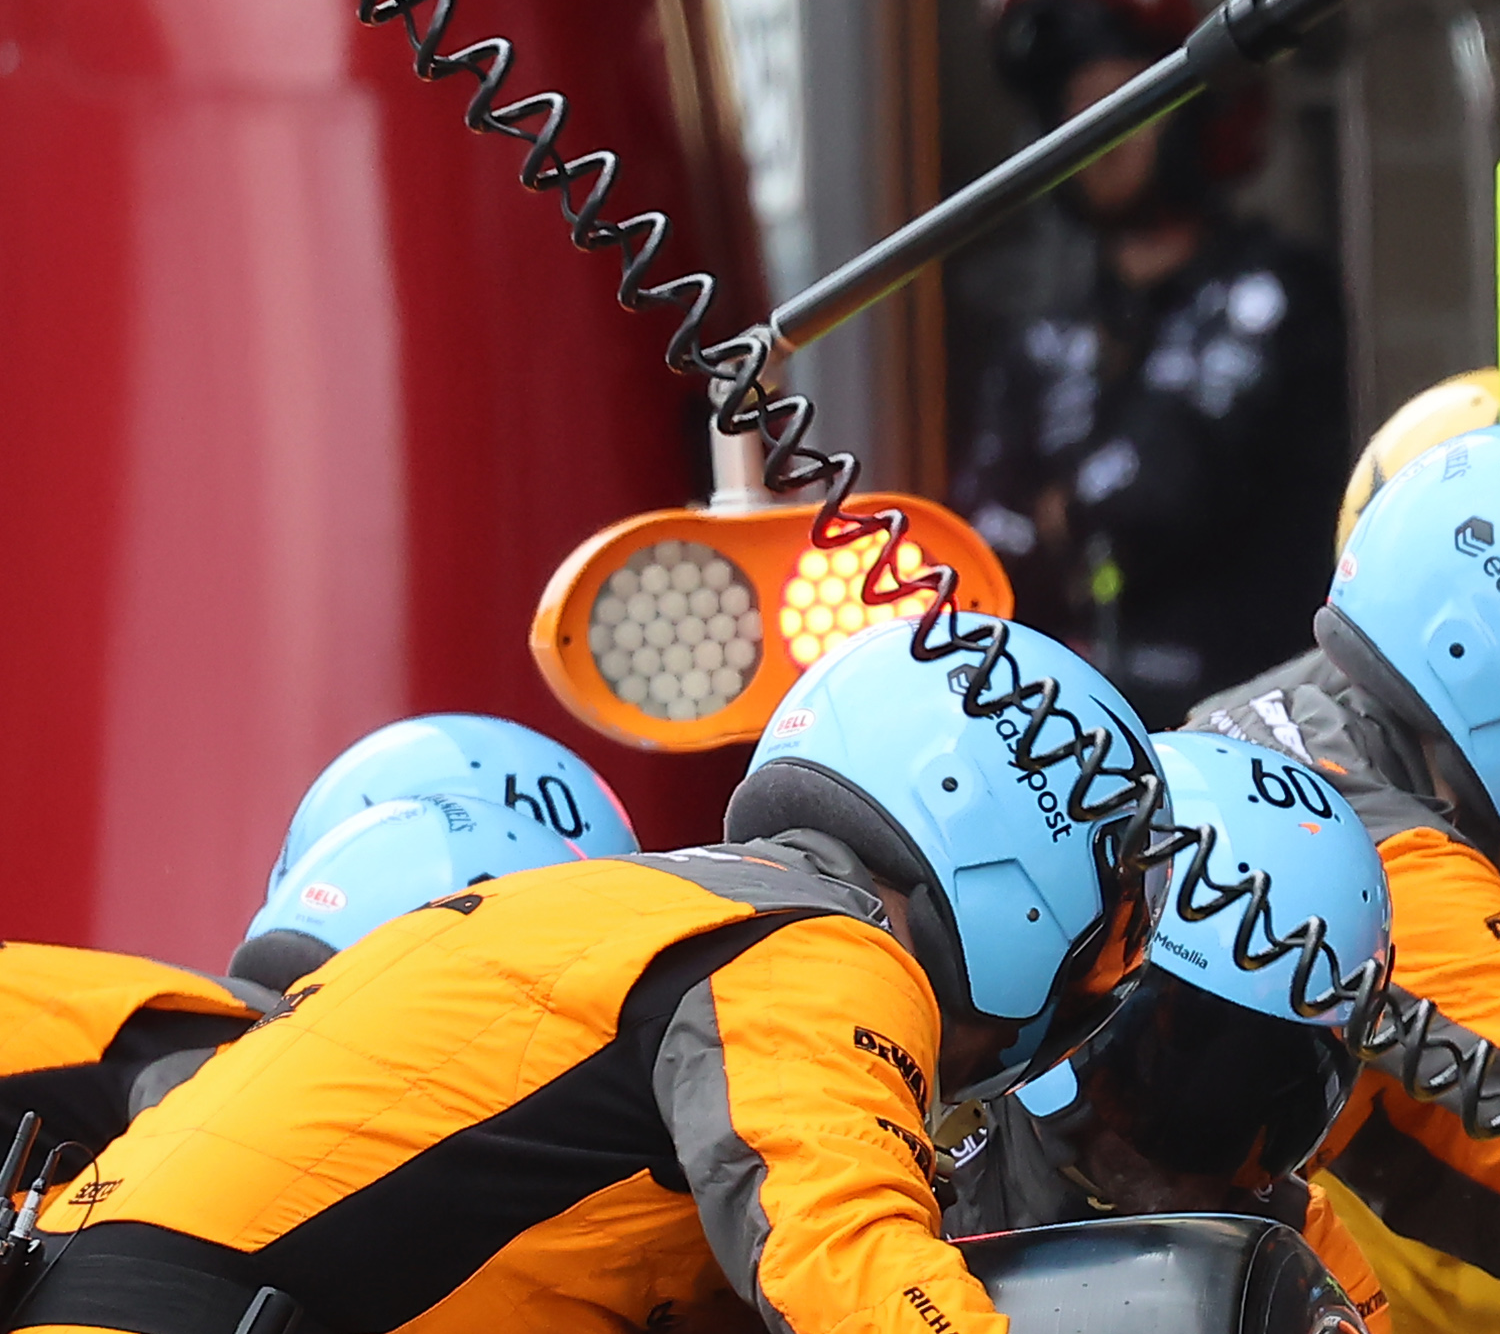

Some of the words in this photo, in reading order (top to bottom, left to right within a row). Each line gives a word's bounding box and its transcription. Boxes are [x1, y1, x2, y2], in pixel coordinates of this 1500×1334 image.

[1251, 757, 1334, 821] 60
[305, 886, 340, 908] BELL
[1153, 930, 1210, 970] Medallia
